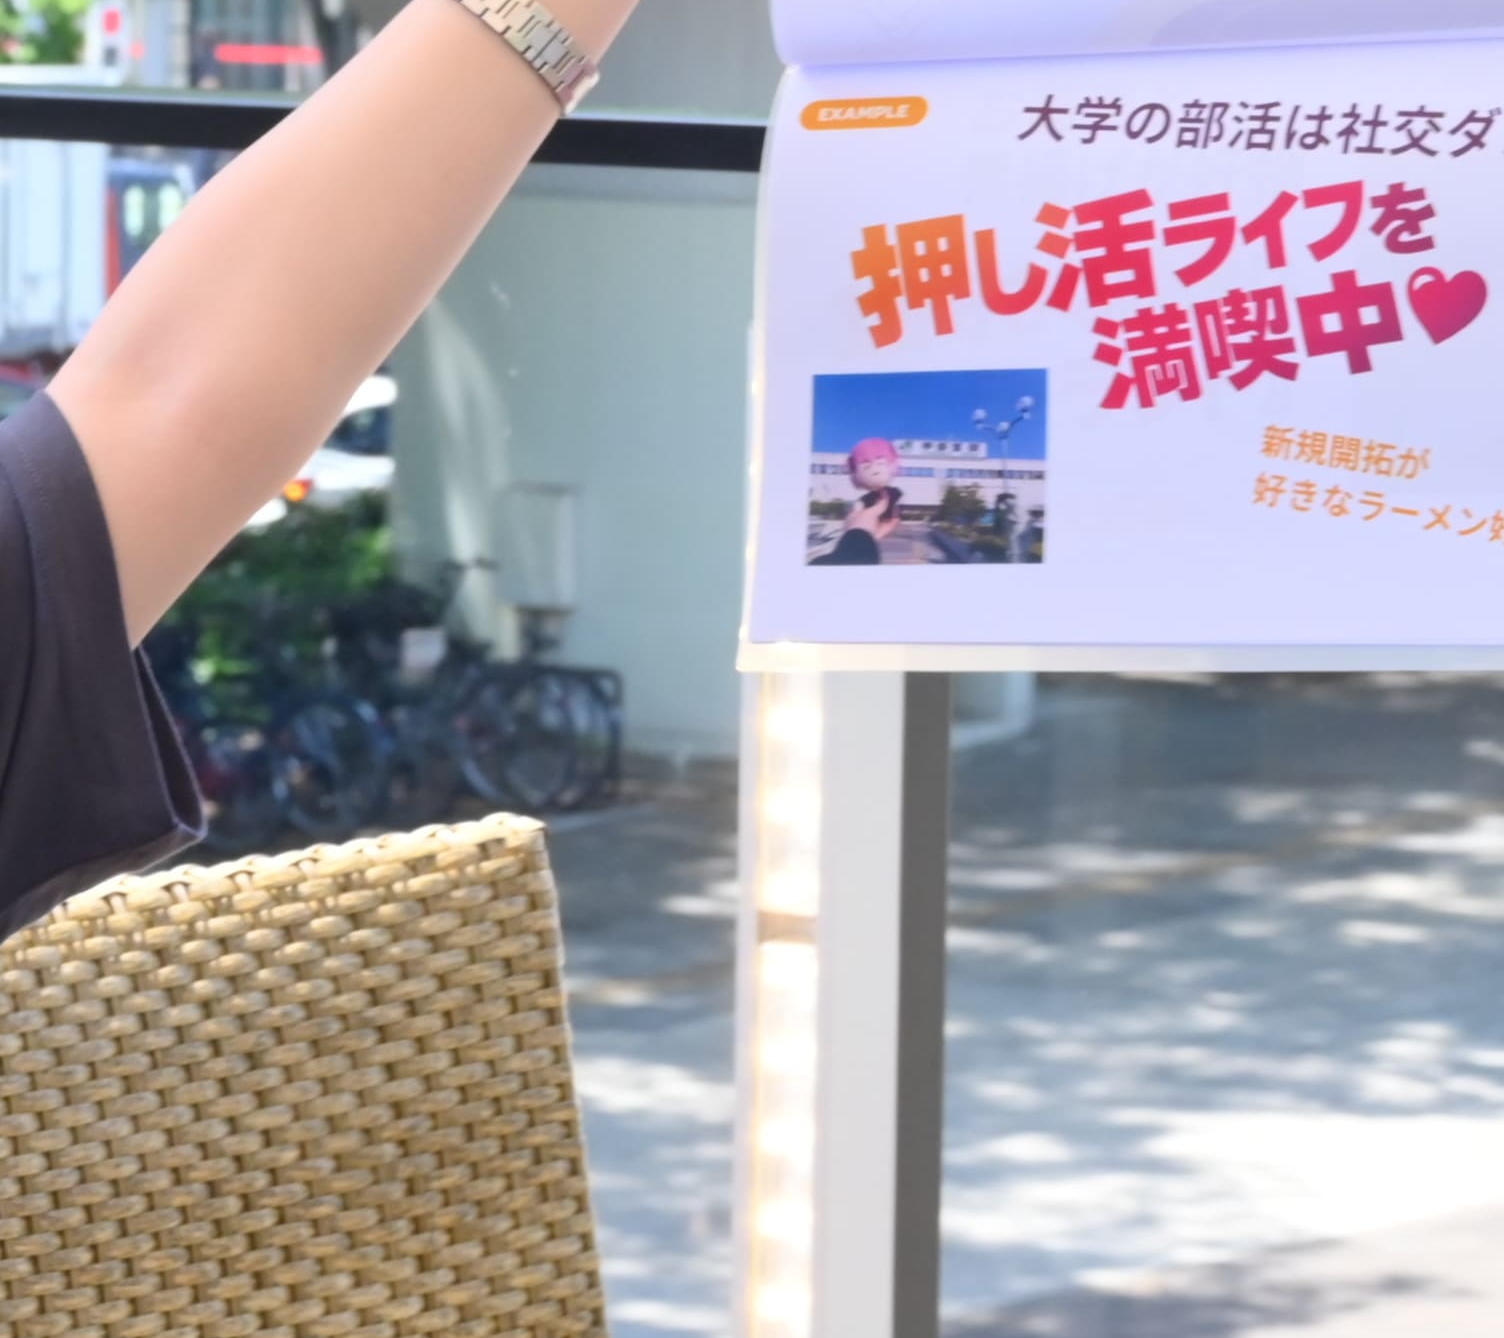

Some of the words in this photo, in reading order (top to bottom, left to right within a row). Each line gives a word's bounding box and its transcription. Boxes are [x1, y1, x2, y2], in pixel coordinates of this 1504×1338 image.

[817, 103, 911, 122] EXAMPLE
[849, 180, 1438, 349] 押し活ライフを
[1090, 268, 1405, 410] 満喫中
[1259, 423, 1433, 480] 新規開拓が
